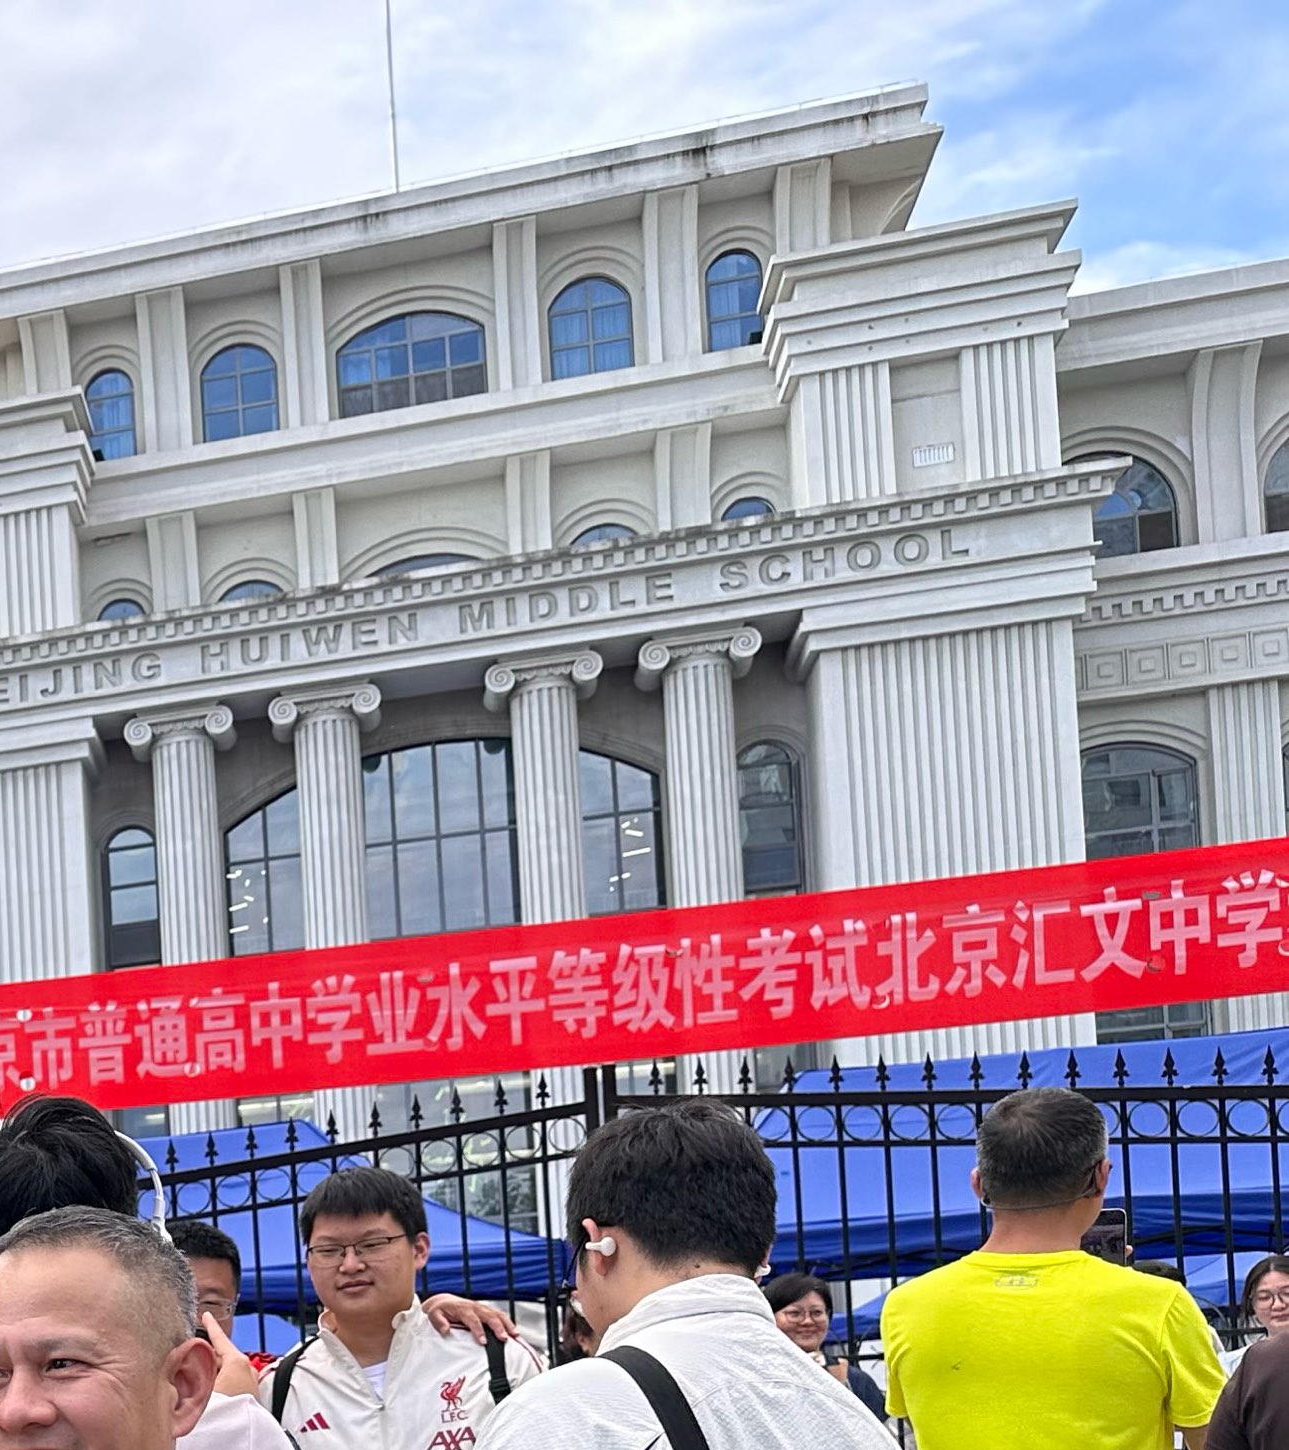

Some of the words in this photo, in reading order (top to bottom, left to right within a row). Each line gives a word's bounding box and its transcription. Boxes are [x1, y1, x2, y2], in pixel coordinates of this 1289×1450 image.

[201, 612, 419, 675] HUIWEN
[458, 571, 674, 634] MIDDLE
[719, 529, 970, 593] SCHOOL
